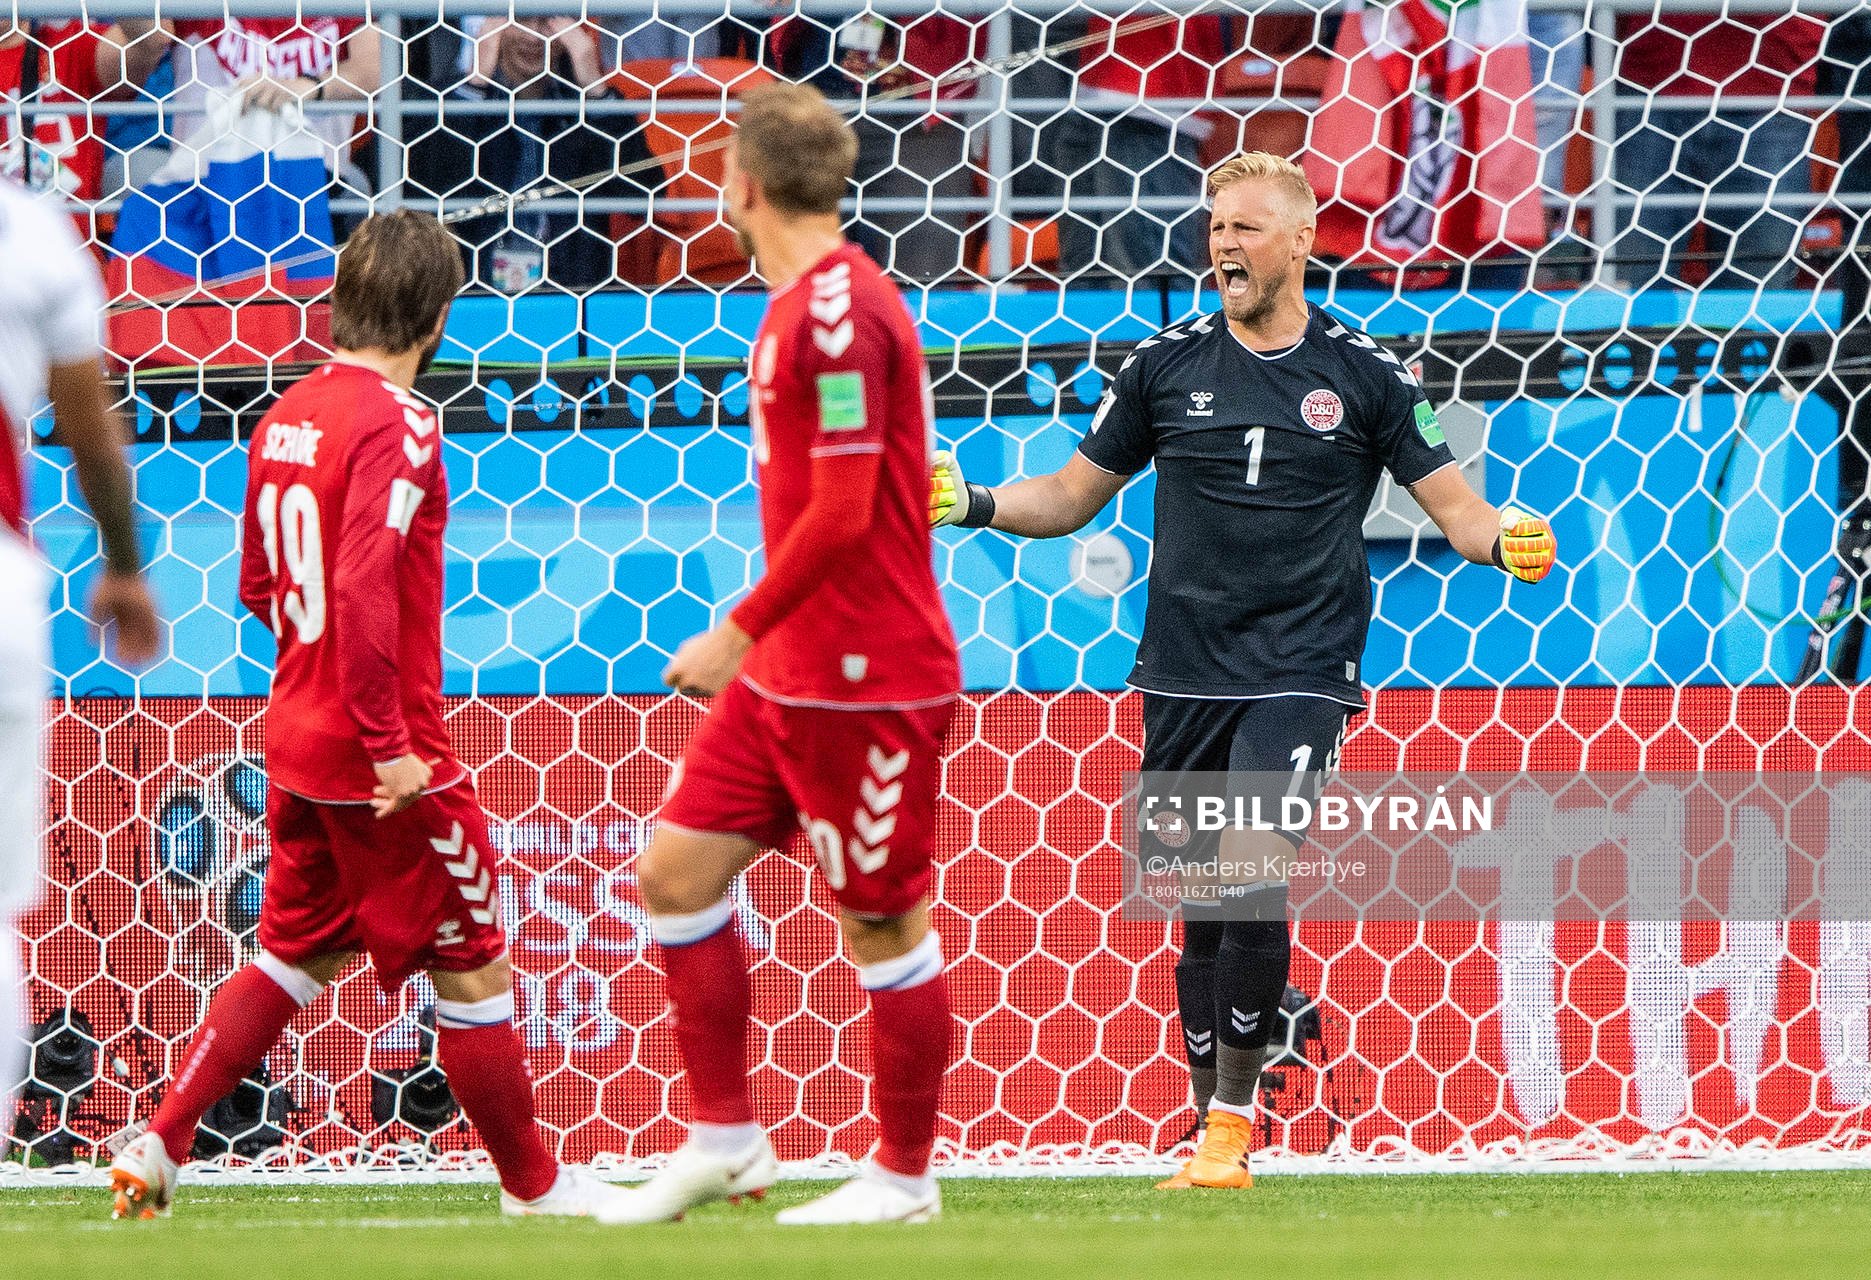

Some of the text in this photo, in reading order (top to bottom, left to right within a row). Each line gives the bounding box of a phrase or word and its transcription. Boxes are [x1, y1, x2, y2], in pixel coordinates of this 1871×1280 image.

[1311, 404, 1334, 415] DBU
[1243, 426, 1266, 486] 1
[257, 483, 326, 644] 19
[1285, 744, 1313, 803] 1
[374, 970, 622, 1052] 218
